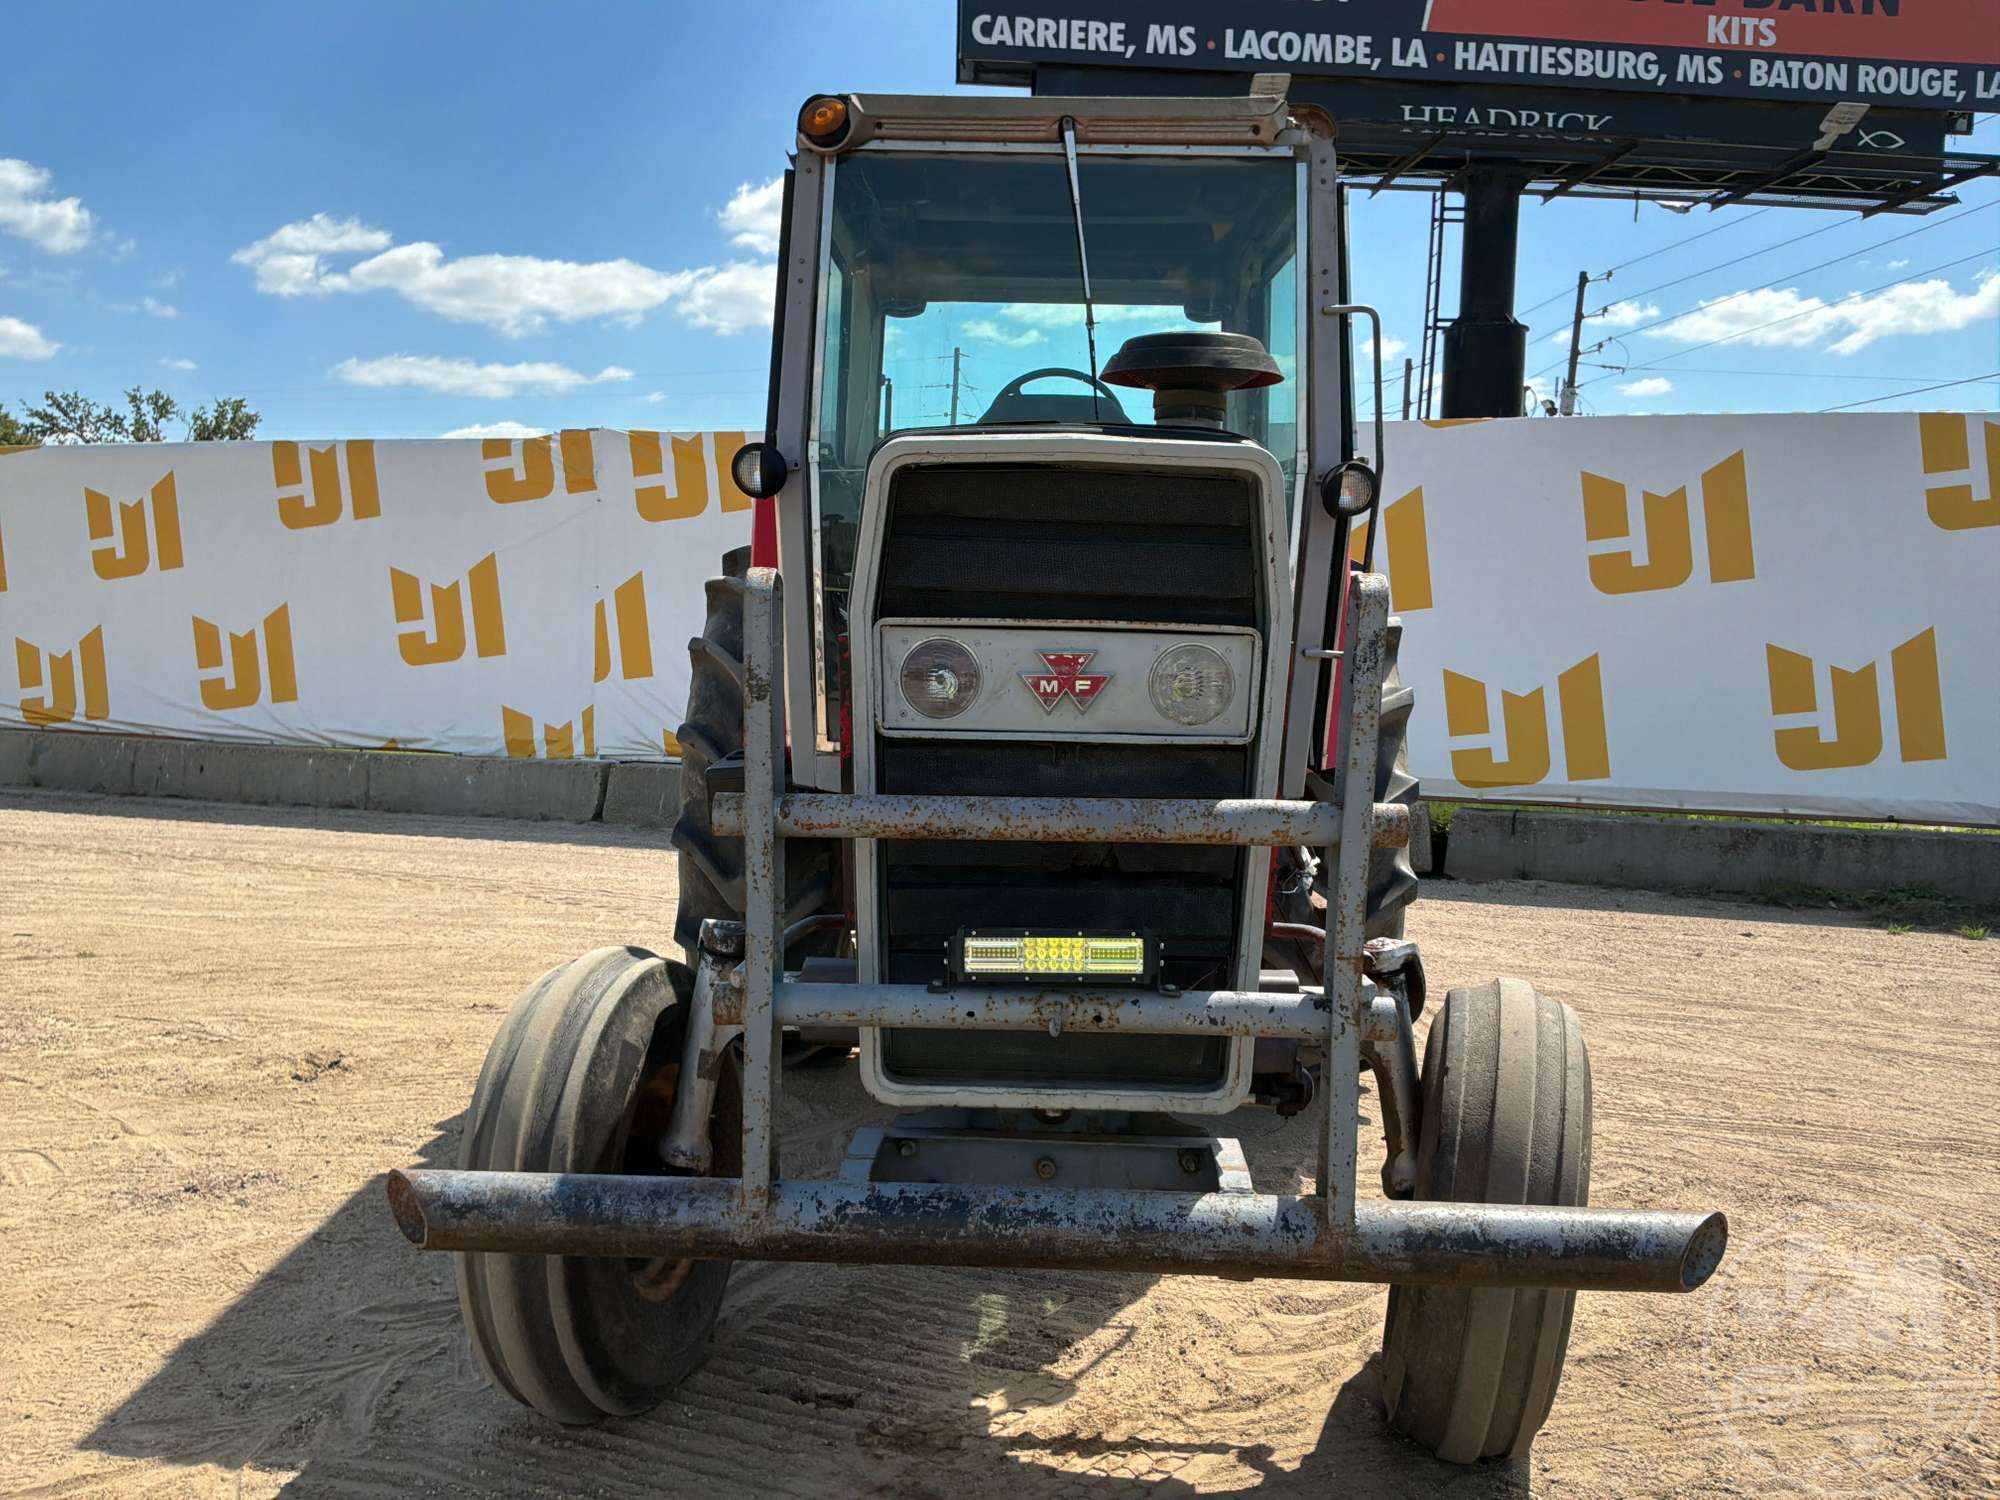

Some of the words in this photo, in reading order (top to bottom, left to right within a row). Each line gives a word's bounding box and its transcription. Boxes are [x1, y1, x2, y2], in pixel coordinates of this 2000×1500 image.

[1707, 15, 1776, 46] KITS
[971, 14, 1136, 59] CARRIERE,
[1145, 25, 1197, 56] MS
[1224, 28, 1382, 71] LACOMBE,
[1391, 37, 1428, 68] LA
[1454, 41, 1667, 86] HATTIESBURG,
[1676, 55, 1724, 85] MS
[1749, 58, 1848, 92] BATON
[1857, 65, 1967, 103] ROUGE,
[1400, 104, 1614, 142] HEADRICK
